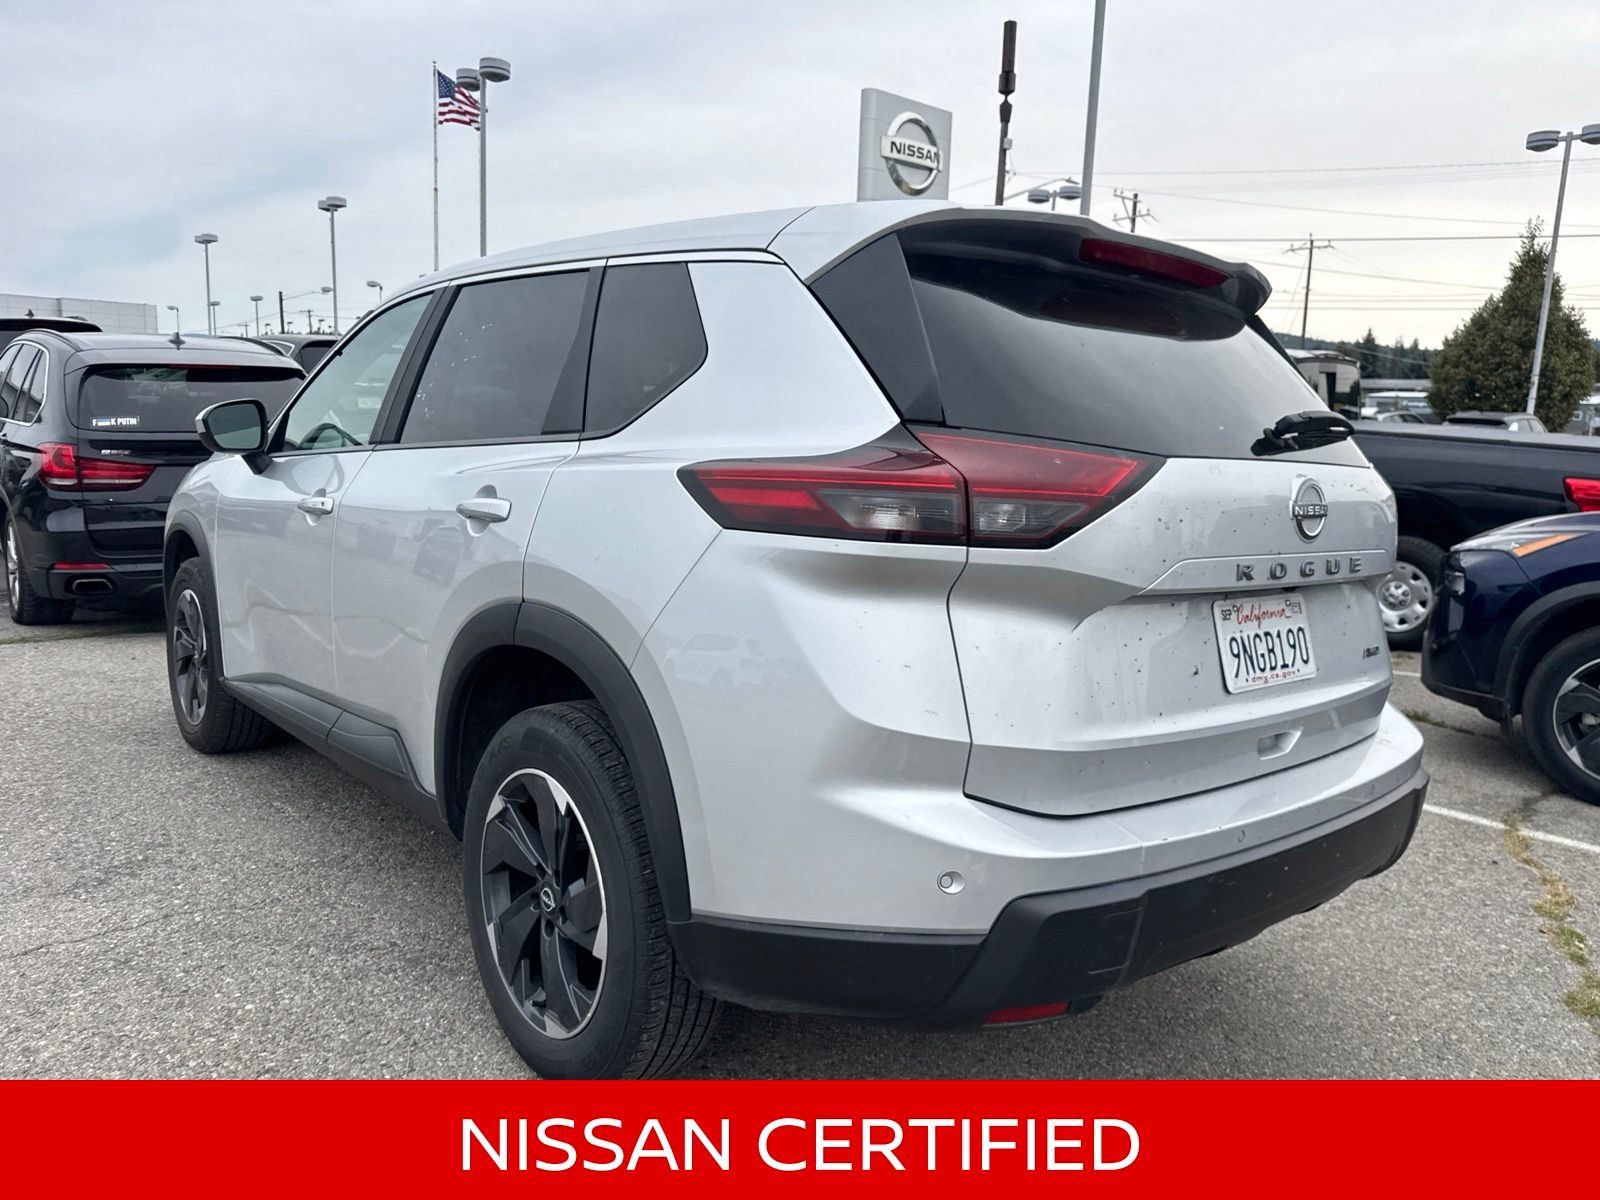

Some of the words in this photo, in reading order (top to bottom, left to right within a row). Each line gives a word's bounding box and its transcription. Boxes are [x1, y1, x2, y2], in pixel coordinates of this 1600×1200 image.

[890, 141, 940, 163] NISSAN
[117, 417, 137, 425] PUTIN
[1236, 558, 1362, 581] ROGUE
[1236, 603, 1292, 628] California
[1229, 626, 1310, 679] 9NGB190
